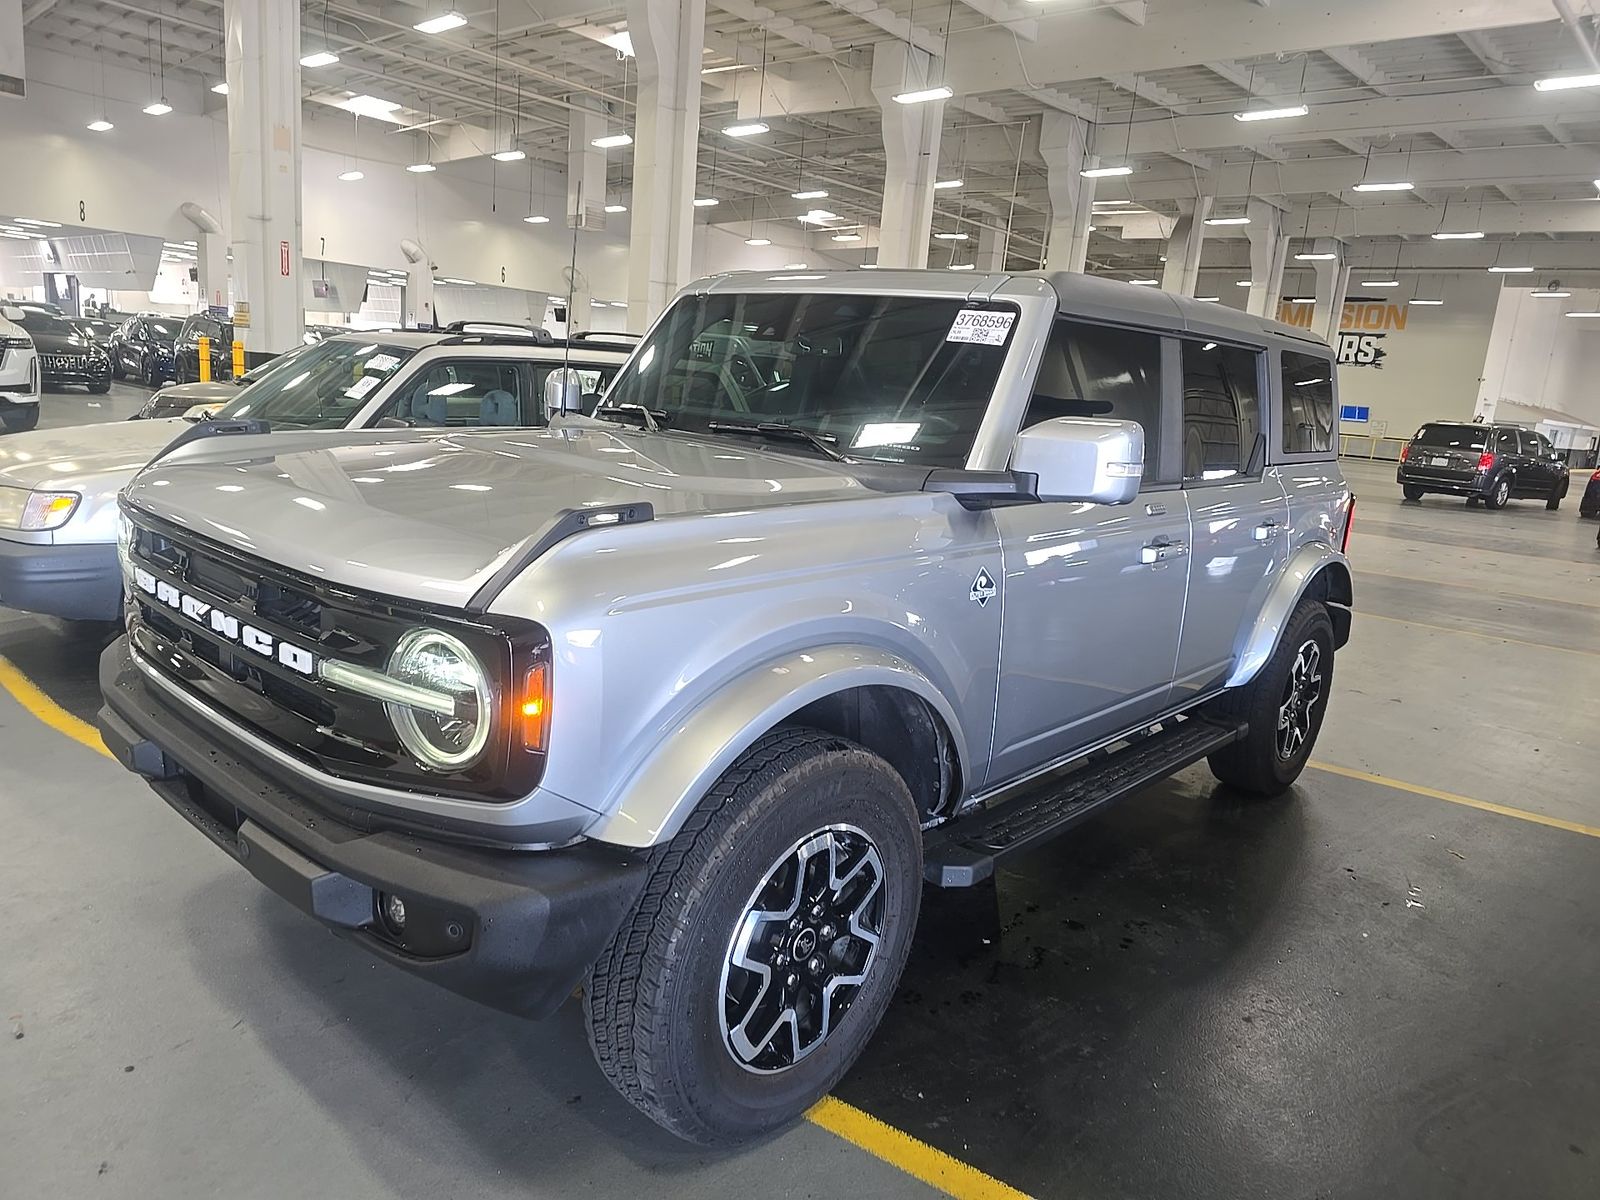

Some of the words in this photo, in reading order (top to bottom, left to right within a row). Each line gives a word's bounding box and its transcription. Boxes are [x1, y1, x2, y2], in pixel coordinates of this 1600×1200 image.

[79, 200, 86, 222] 8
[320, 236, 325, 256] 7
[501, 266, 506, 283] 6
[956, 314, 1013, 329] 3768596
[134, 566, 313, 675] BRONCO
